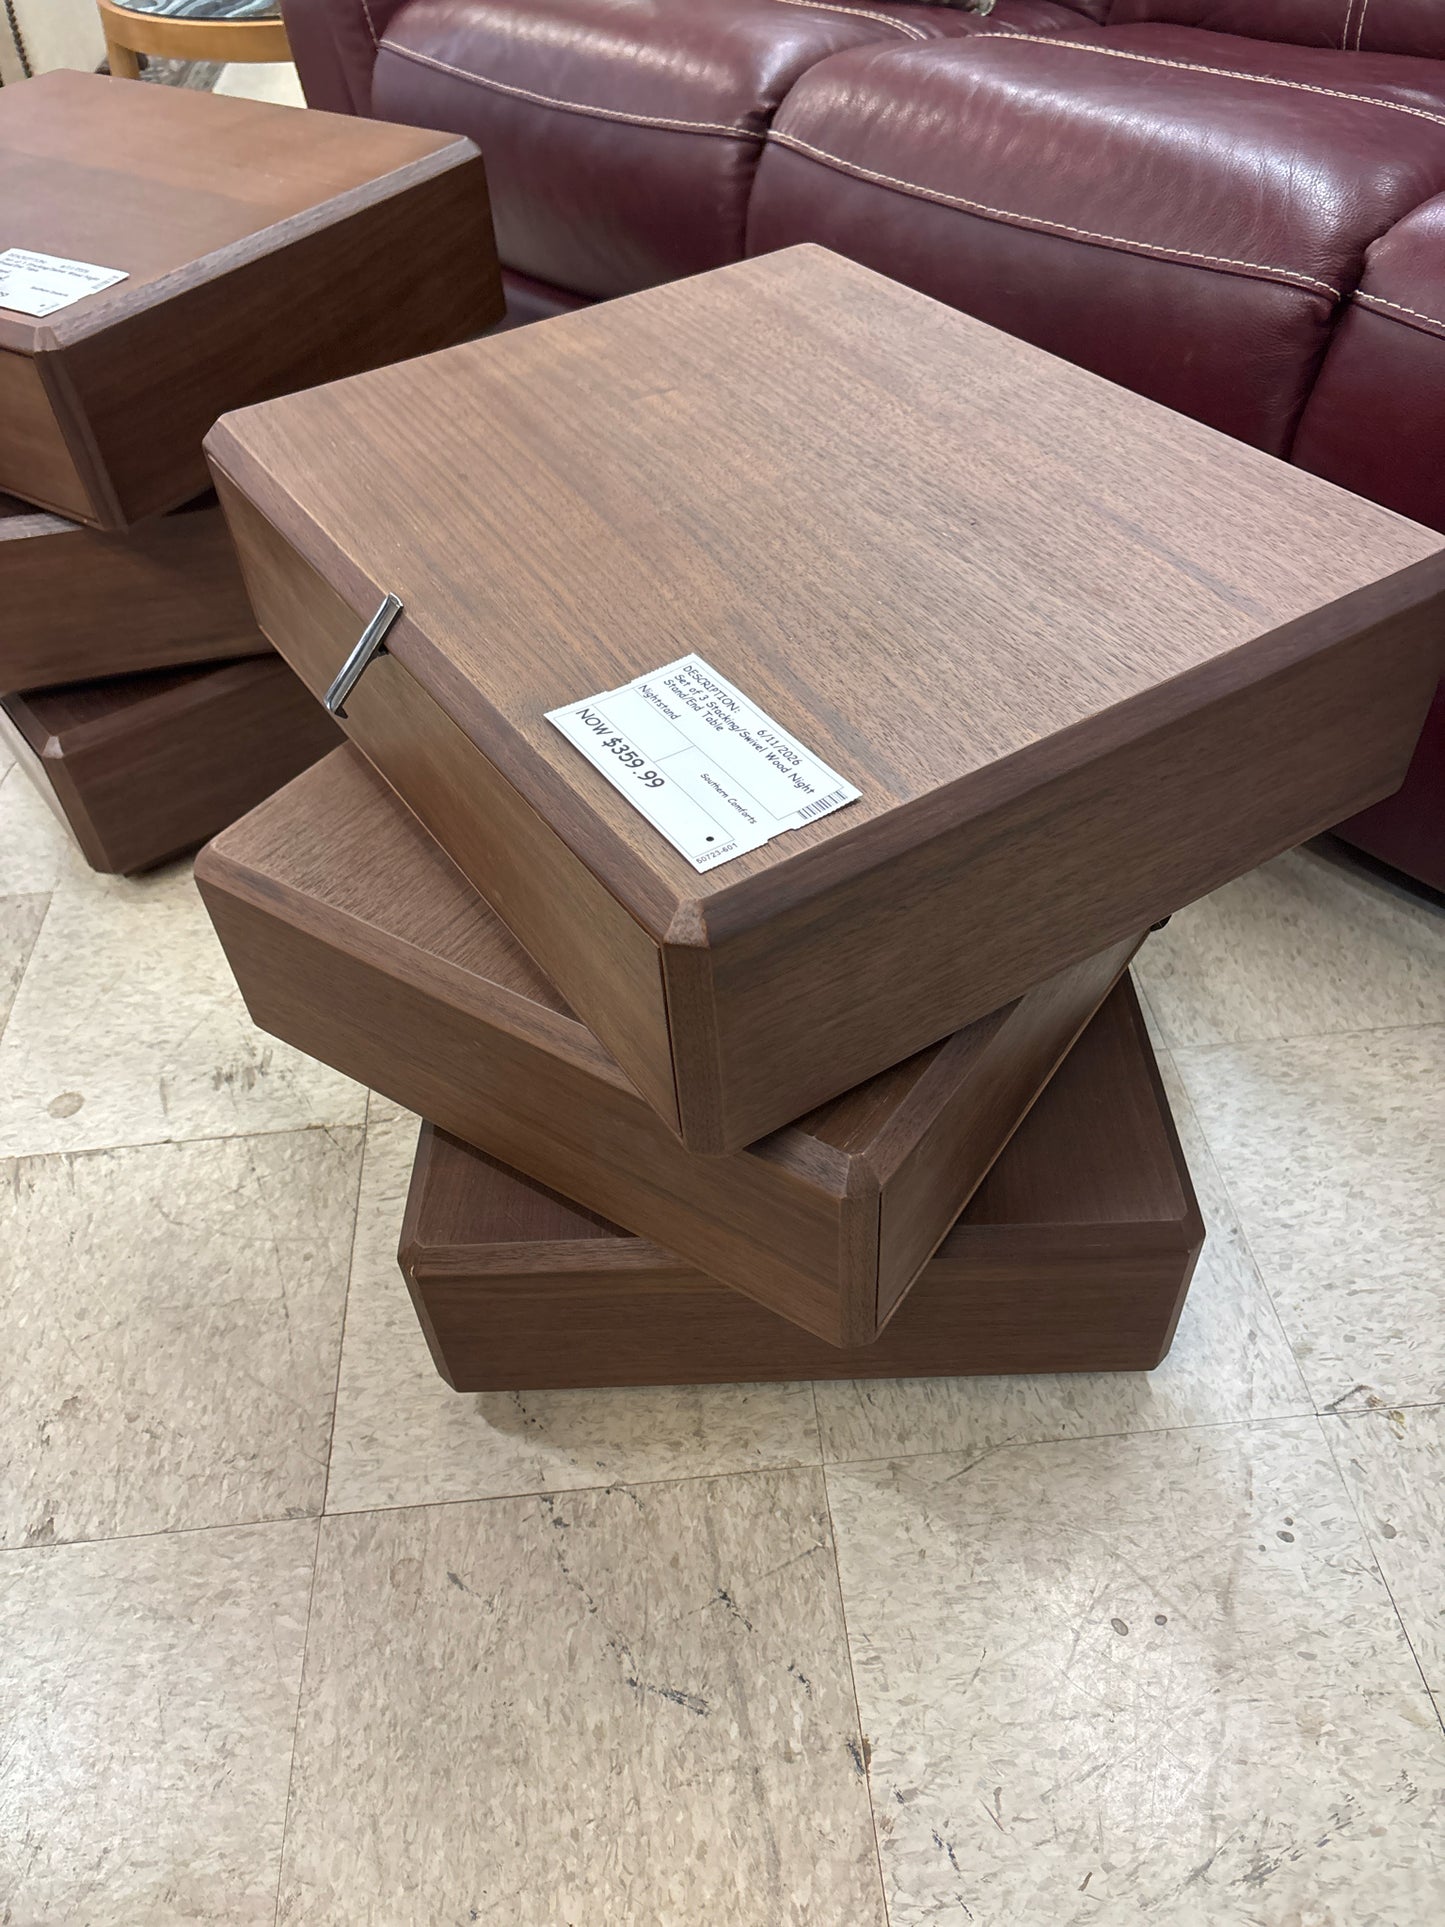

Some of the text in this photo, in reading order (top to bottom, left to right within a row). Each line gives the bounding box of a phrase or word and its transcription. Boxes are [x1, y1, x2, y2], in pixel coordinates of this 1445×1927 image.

[638, 684, 682, 720] Nightstand
[663, 679, 724, 732] Stand/End Table
[674, 674, 815, 794] Set of 3 Stacking/Swivel Wood Night
[683, 665, 803, 766] DESCRIPTION: 6/11/2026
[576, 708, 665, 788] NOW $359.99
[700, 773, 757, 824] Southern Comforts
